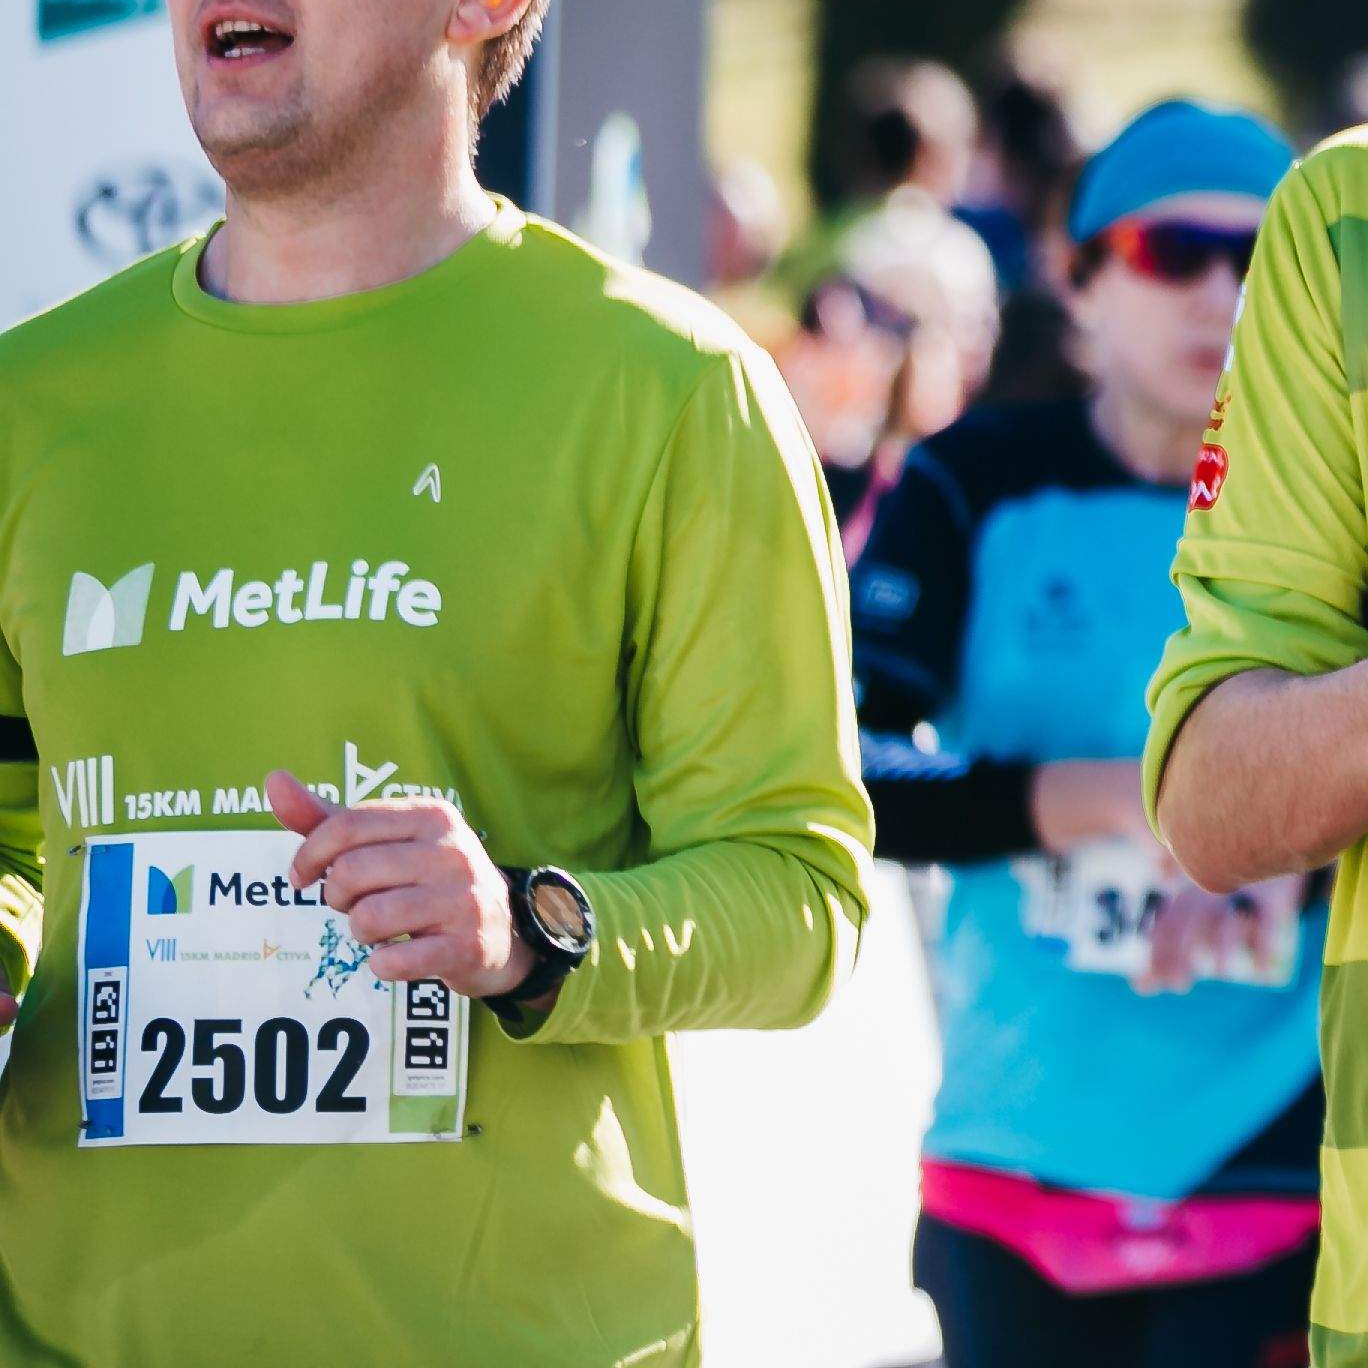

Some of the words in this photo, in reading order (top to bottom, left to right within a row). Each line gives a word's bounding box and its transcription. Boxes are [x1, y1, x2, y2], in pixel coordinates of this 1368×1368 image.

[168, 559, 442, 631] MetLife
[50, 754, 114, 828] VIII
[124, 789, 201, 821] 15KM
[146, 938, 177, 962] VIII
[181, 951, 209, 961] 15KM
[213, 951, 261, 961] MADRID
[138, 1016, 370, 1115] 2502
